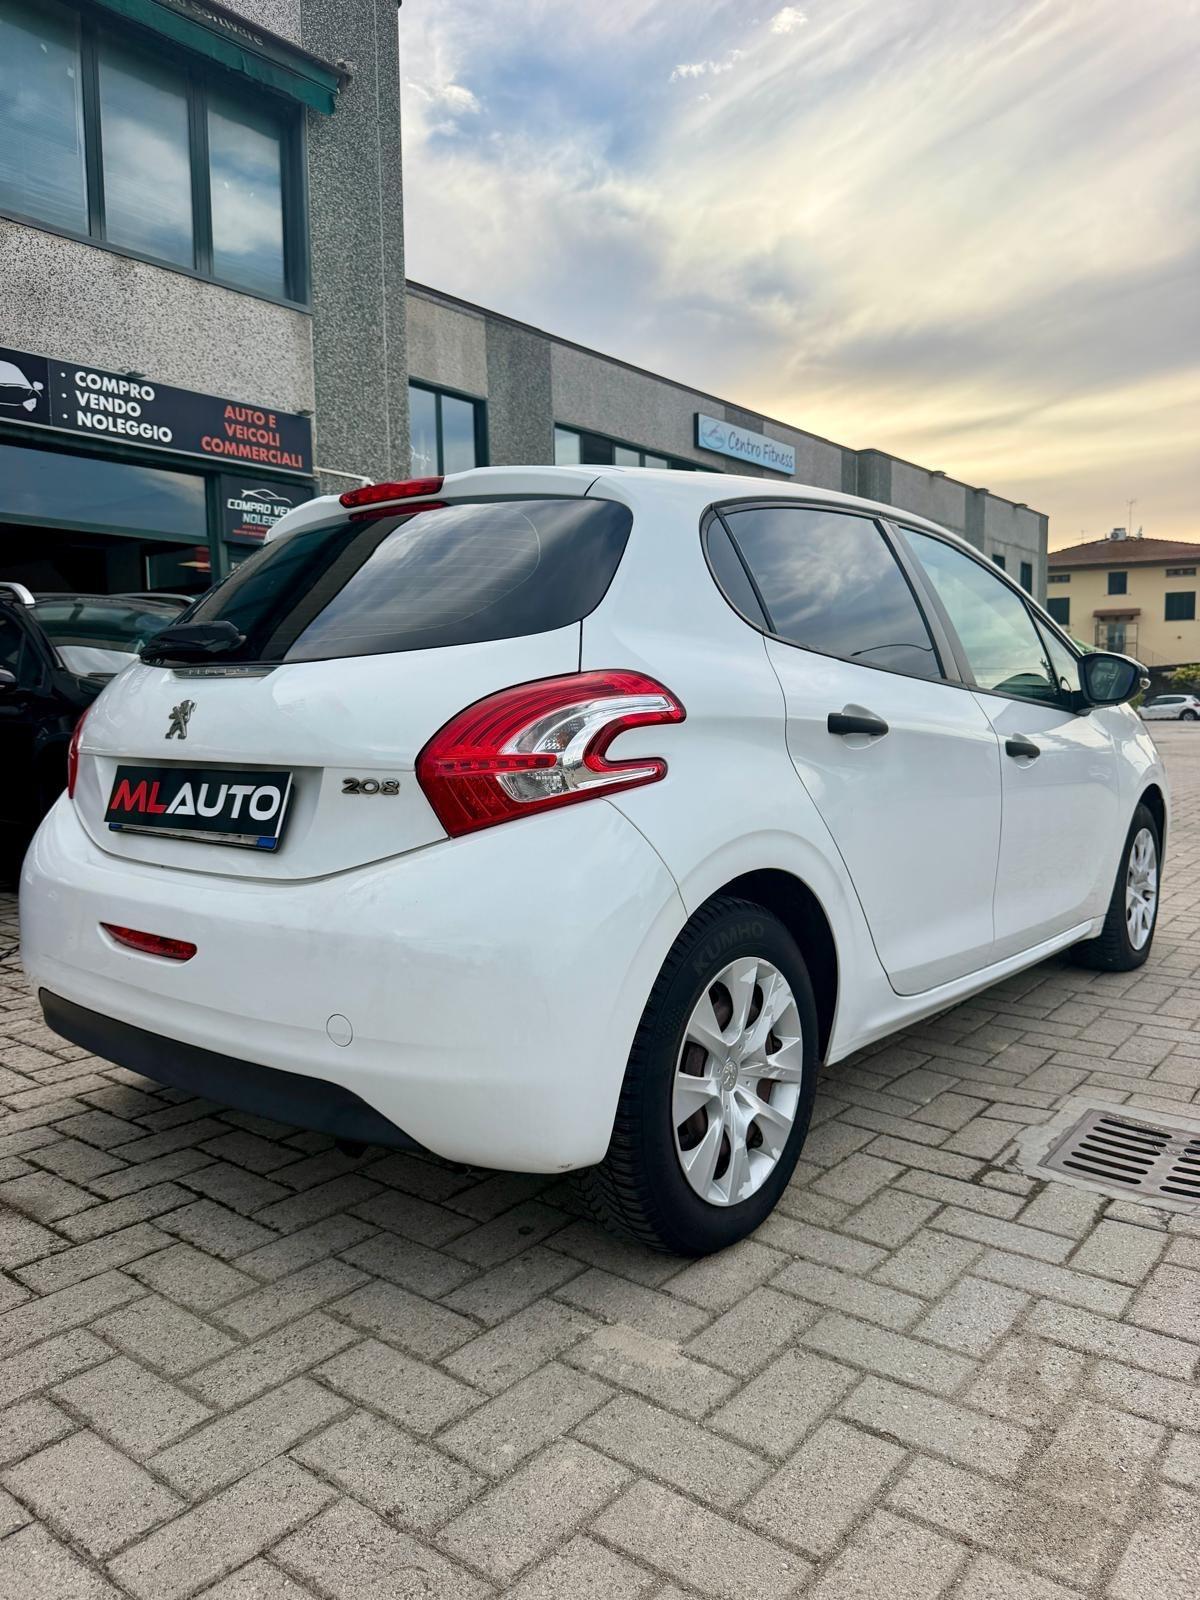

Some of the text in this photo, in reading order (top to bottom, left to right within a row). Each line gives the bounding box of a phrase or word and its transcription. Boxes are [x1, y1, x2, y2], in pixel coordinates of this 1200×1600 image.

[74, 370, 155, 402] COMPRO
[75, 390, 142, 418] VENDO
[224, 404, 277, 429] AUTO E
[77, 409, 173, 444] NOLEGGIO
[224, 421, 280, 448] VEICOLI
[201, 435, 303, 469] COMMERCIALI
[728, 431, 794, 469] Centro Fitness
[227, 498, 272, 515] COMPRO
[341, 777, 400, 797] 208
[693, 921, 764, 977] KUMHO
